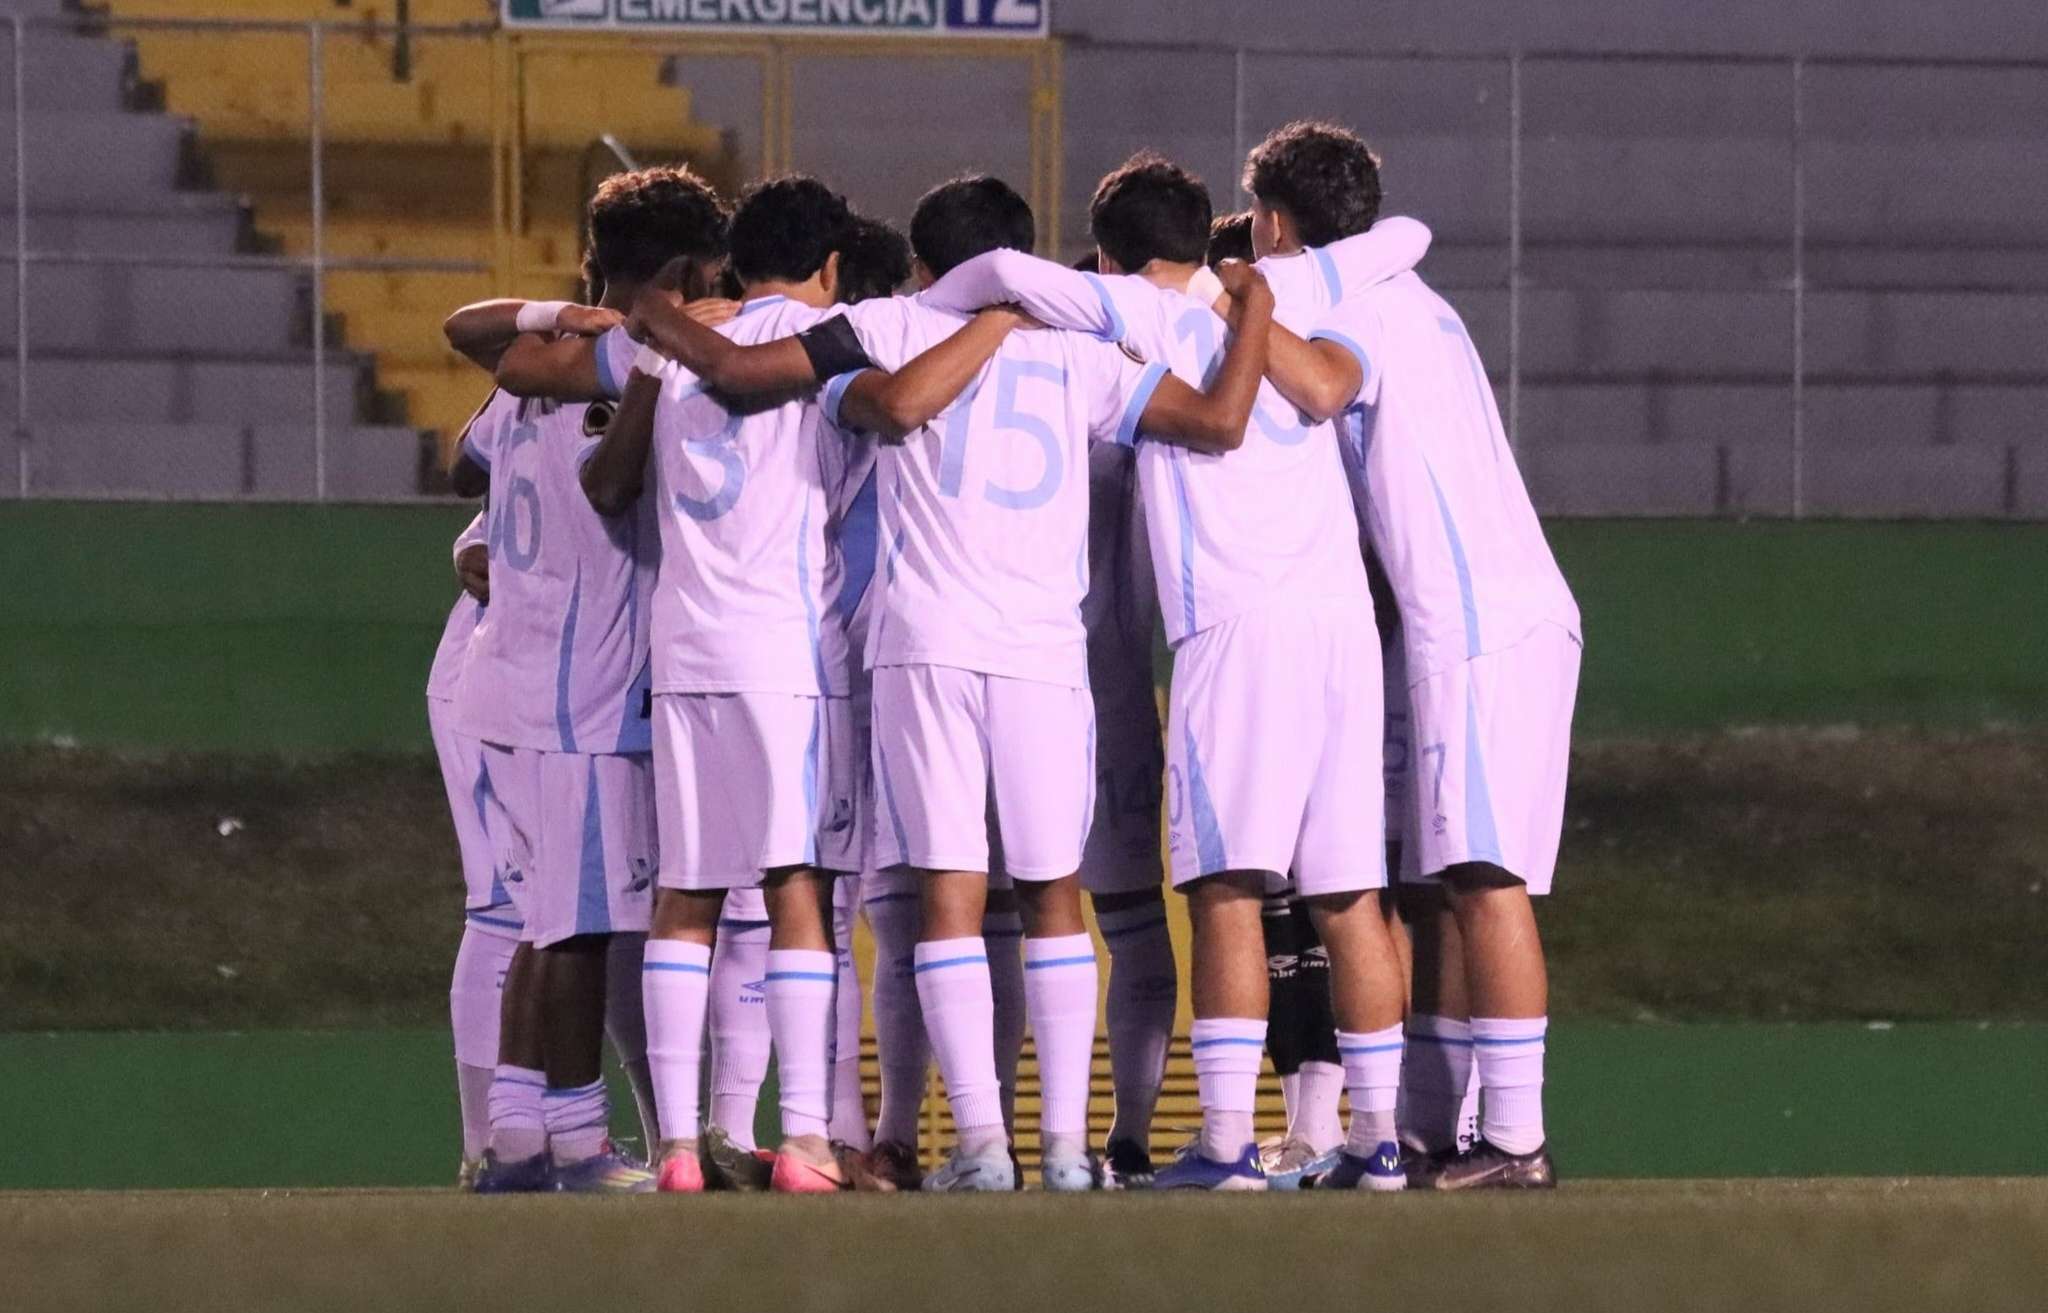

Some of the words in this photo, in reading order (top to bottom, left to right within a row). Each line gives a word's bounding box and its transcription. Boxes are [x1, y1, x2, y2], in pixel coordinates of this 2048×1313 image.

[675, 384, 748, 522] 3
[938, 356, 1069, 511] 15
[1422, 742, 1446, 811] 7
